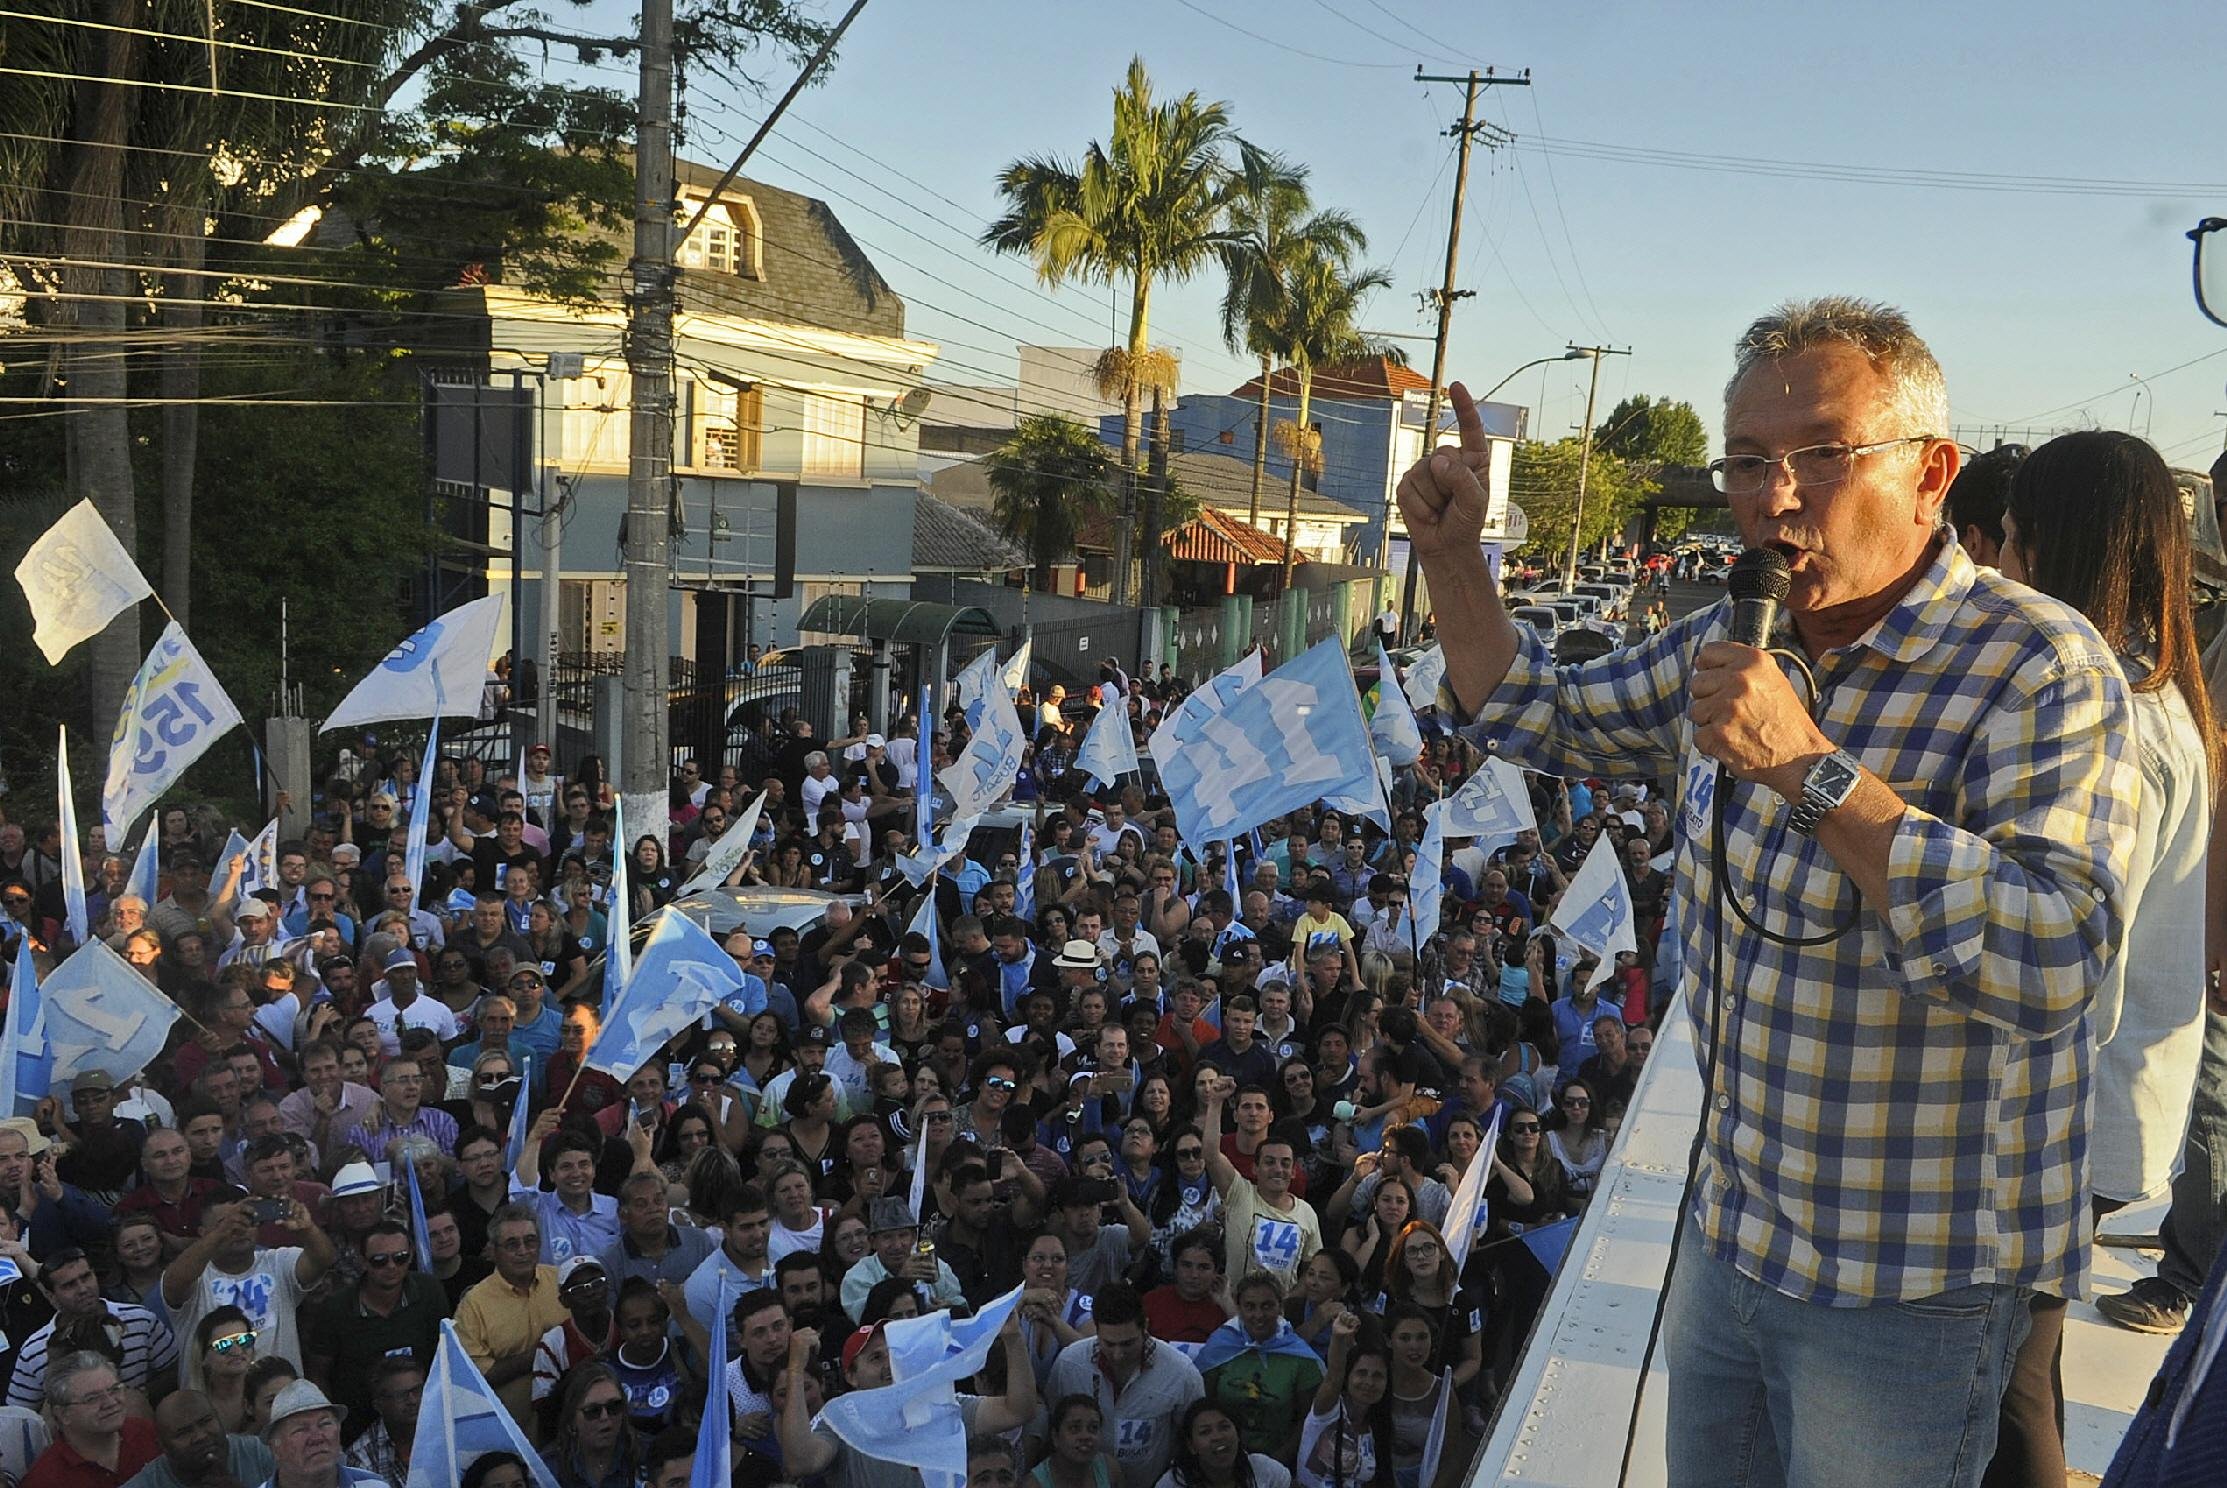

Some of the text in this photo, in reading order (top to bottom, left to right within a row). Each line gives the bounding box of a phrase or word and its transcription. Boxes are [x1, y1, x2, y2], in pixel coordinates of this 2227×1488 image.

[1686, 765, 1714, 817] 14
[1256, 1221, 1298, 1258] 14
[227, 1279, 269, 1317] 14
[1120, 1421, 1152, 1445] 14
